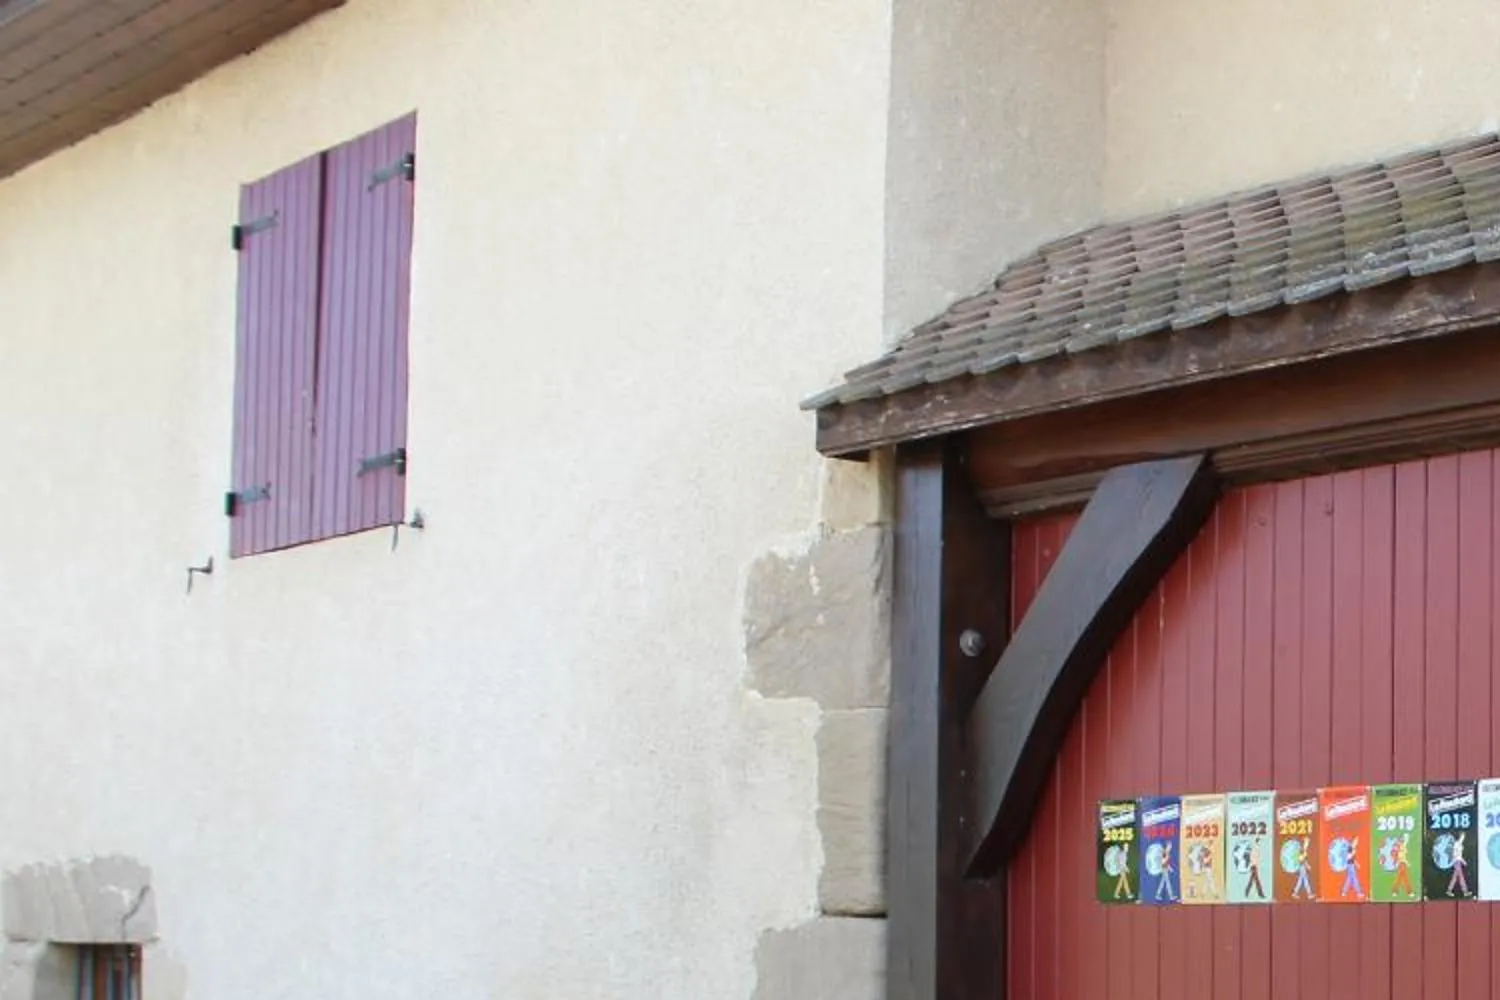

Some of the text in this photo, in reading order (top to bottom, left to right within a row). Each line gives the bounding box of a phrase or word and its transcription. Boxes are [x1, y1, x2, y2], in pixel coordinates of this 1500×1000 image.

[1231, 821, 1267, 837] 2022
[1279, 819, 1313, 835] 2021
[1430, 813, 1471, 829] 2018
